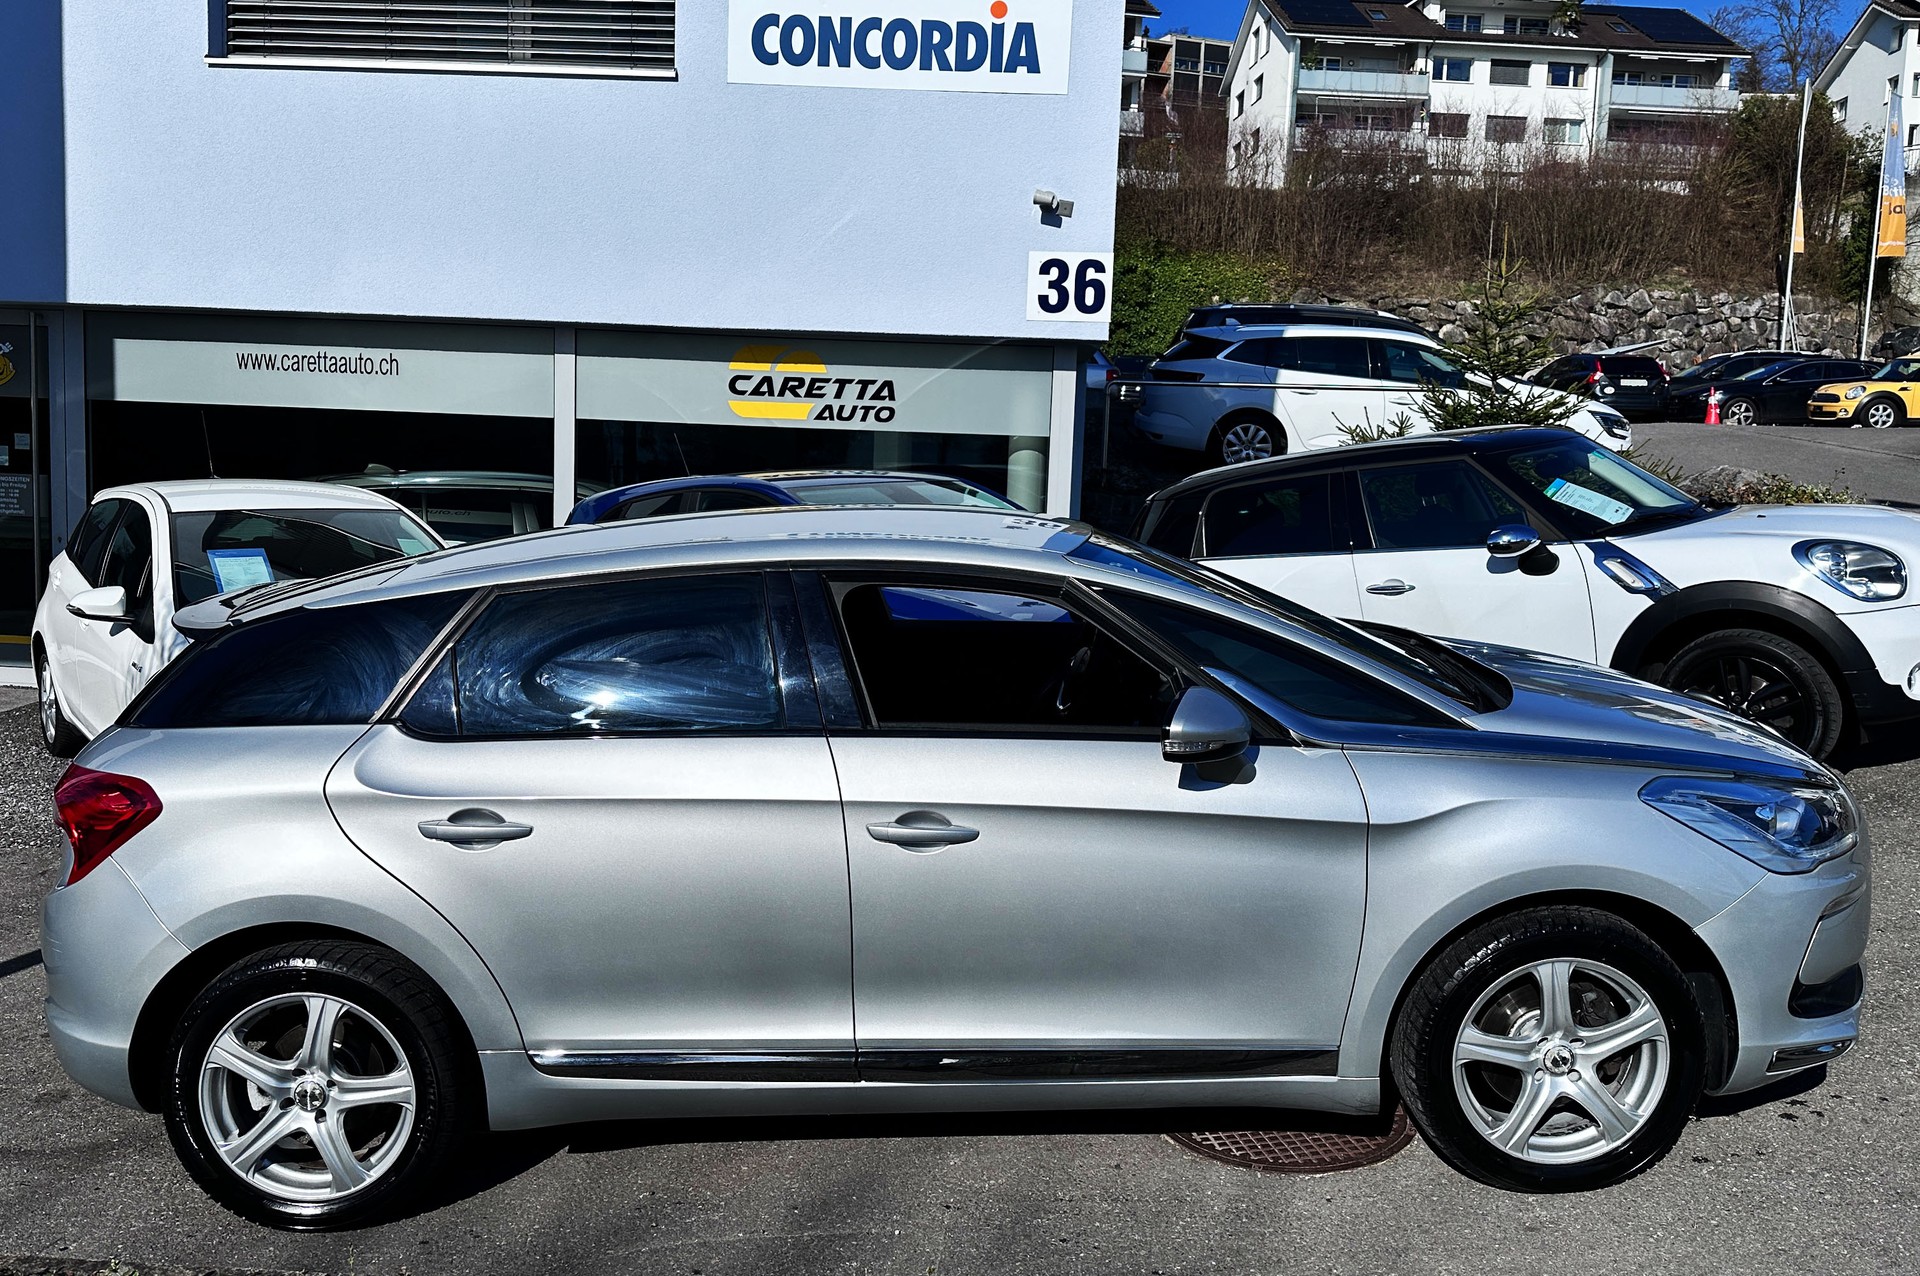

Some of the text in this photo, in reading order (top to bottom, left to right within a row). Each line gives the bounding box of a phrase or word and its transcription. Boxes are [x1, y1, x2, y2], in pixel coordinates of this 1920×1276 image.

[751, 0, 1041, 74] CONCORDIA
[1037, 257, 1107, 315] 36
[236, 350, 399, 376] www.carettaauto.ch
[728, 374, 896, 402] CARETTA
[813, 403, 896, 423] AUTO
